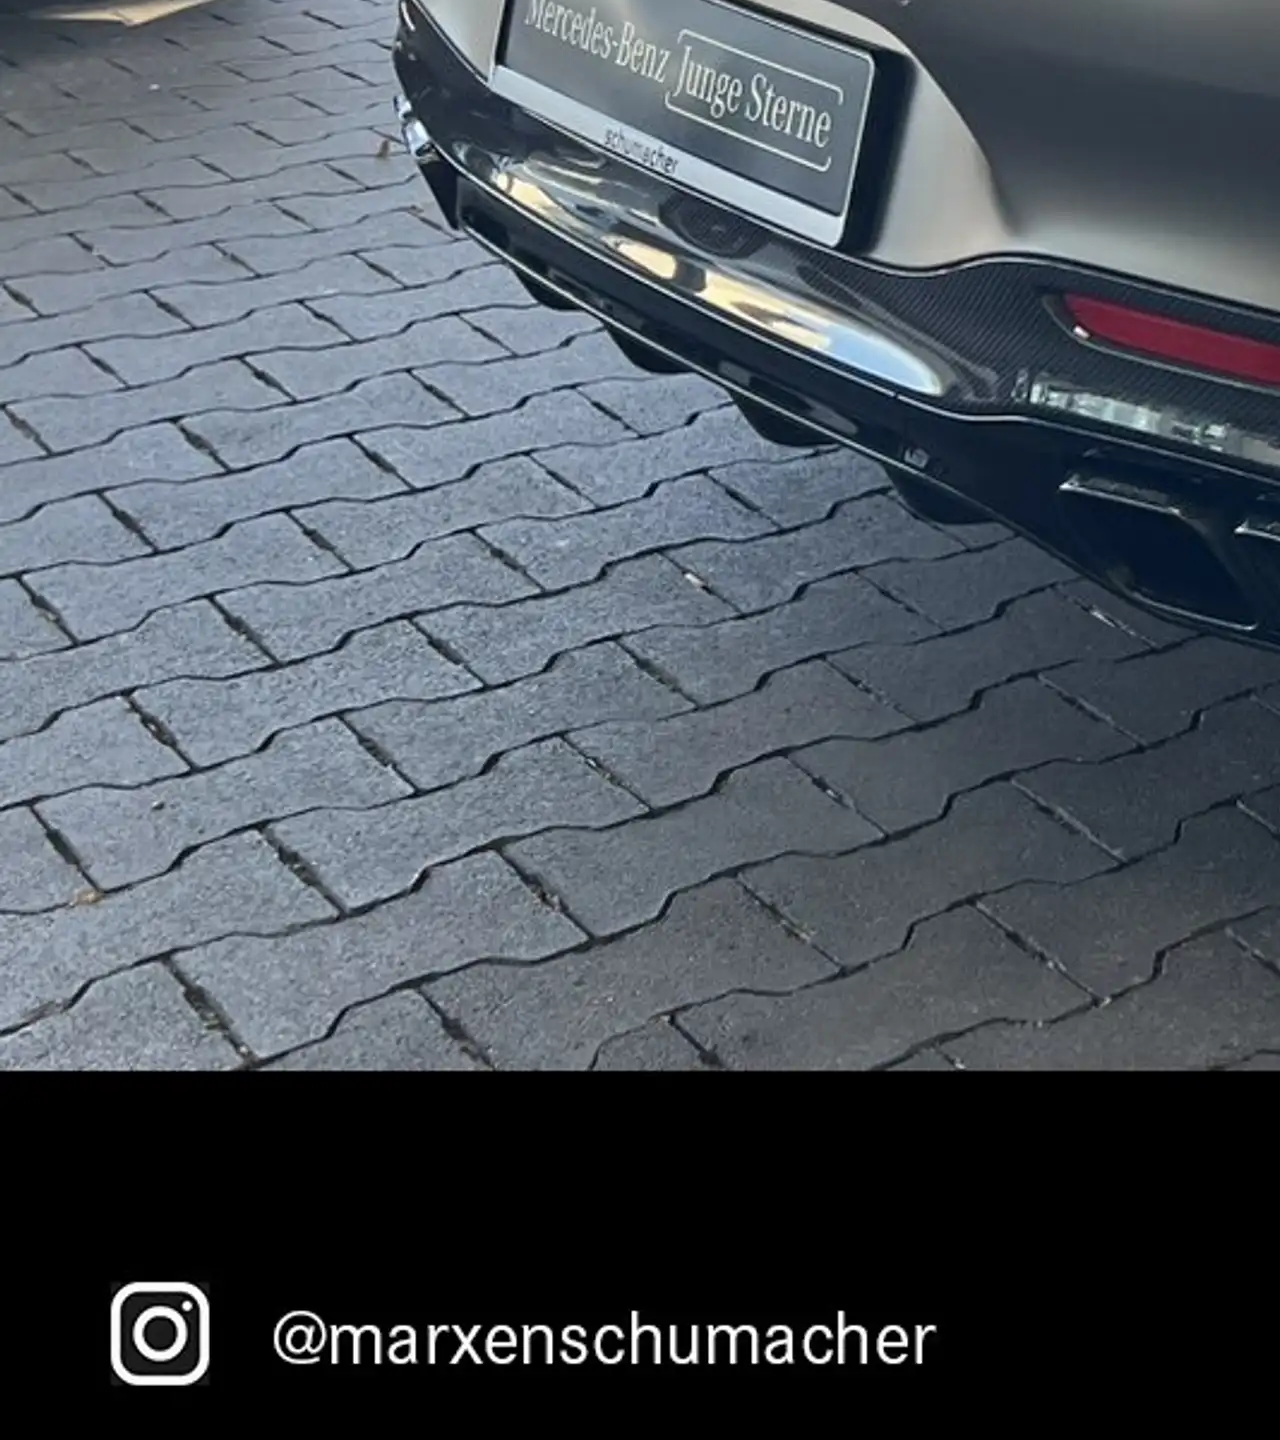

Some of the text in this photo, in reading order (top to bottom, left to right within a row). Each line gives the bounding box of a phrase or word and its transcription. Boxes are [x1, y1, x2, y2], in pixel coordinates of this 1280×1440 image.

[671, 44, 744, 119] Junge
[743, 72, 832, 148] Sterne
[604, 128, 679, 174] schumacher
